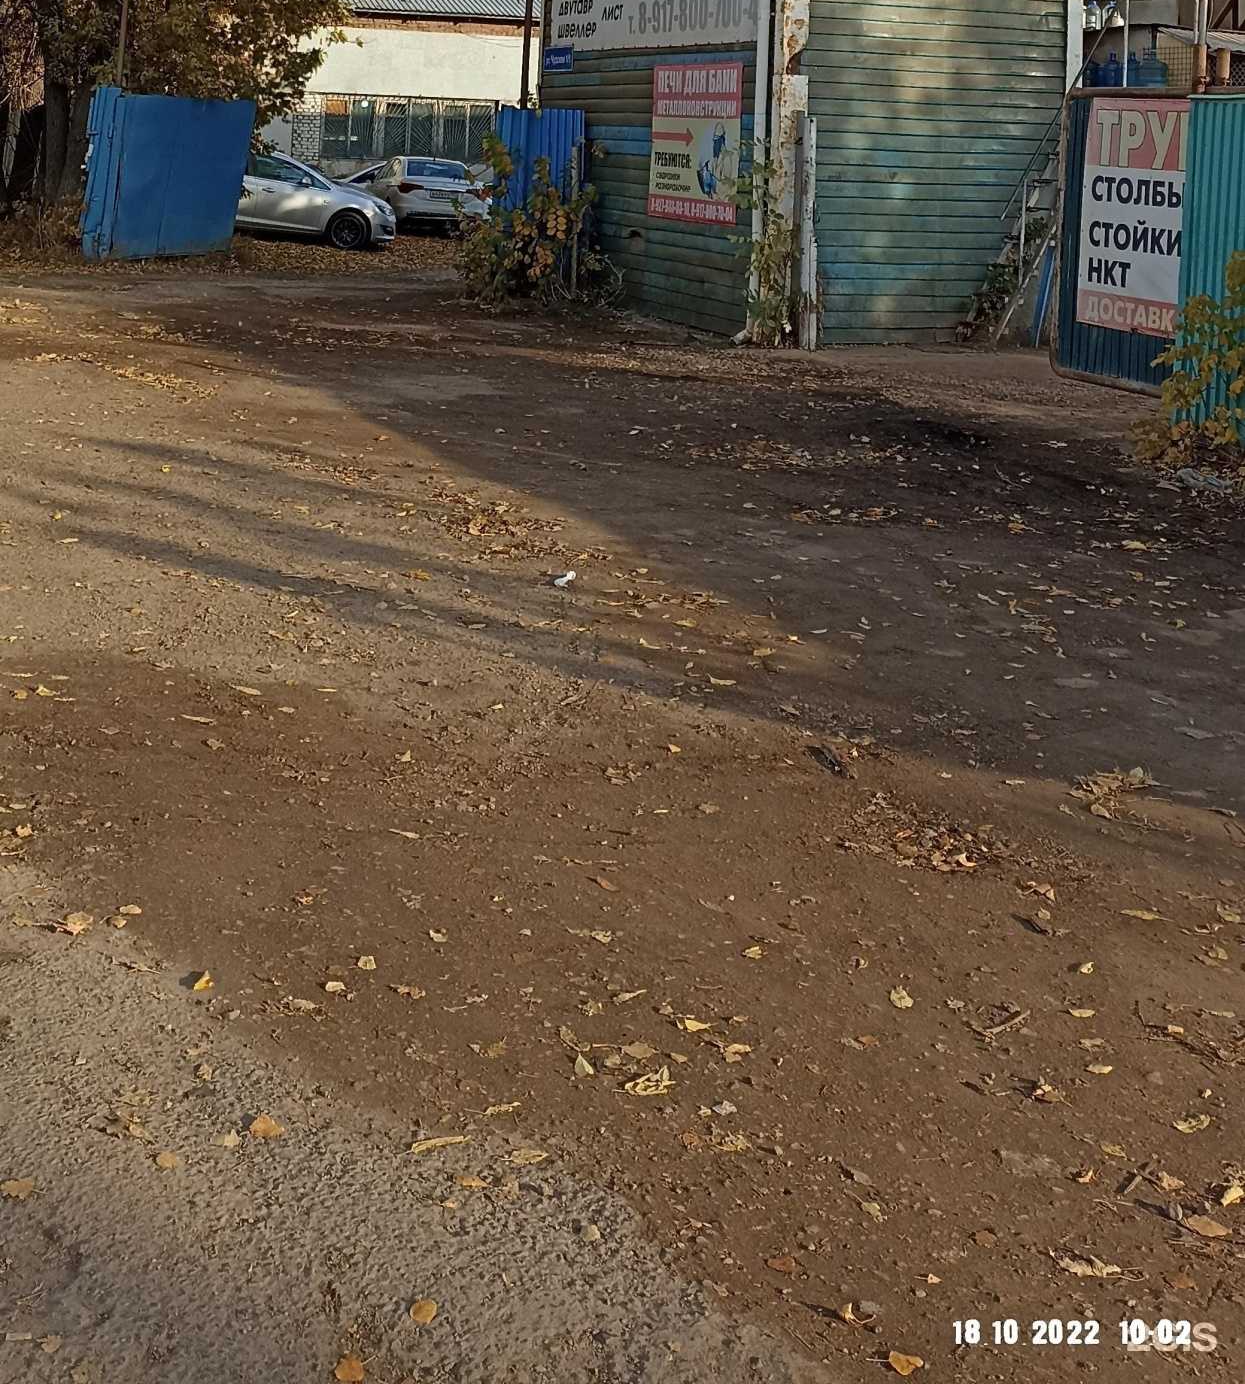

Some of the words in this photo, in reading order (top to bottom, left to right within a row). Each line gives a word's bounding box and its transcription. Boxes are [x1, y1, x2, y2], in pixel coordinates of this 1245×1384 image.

[658, 70, 682, 93] ПЕЧИ
[683, 70, 706, 96] ДЛЯ
[708, 68, 737, 93] БАНИ
[1097, 108, 1188, 171] ТРУ
[1089, 219, 1182, 257] СТОЙКИ
[1087, 257, 1131, 288] НКТ
